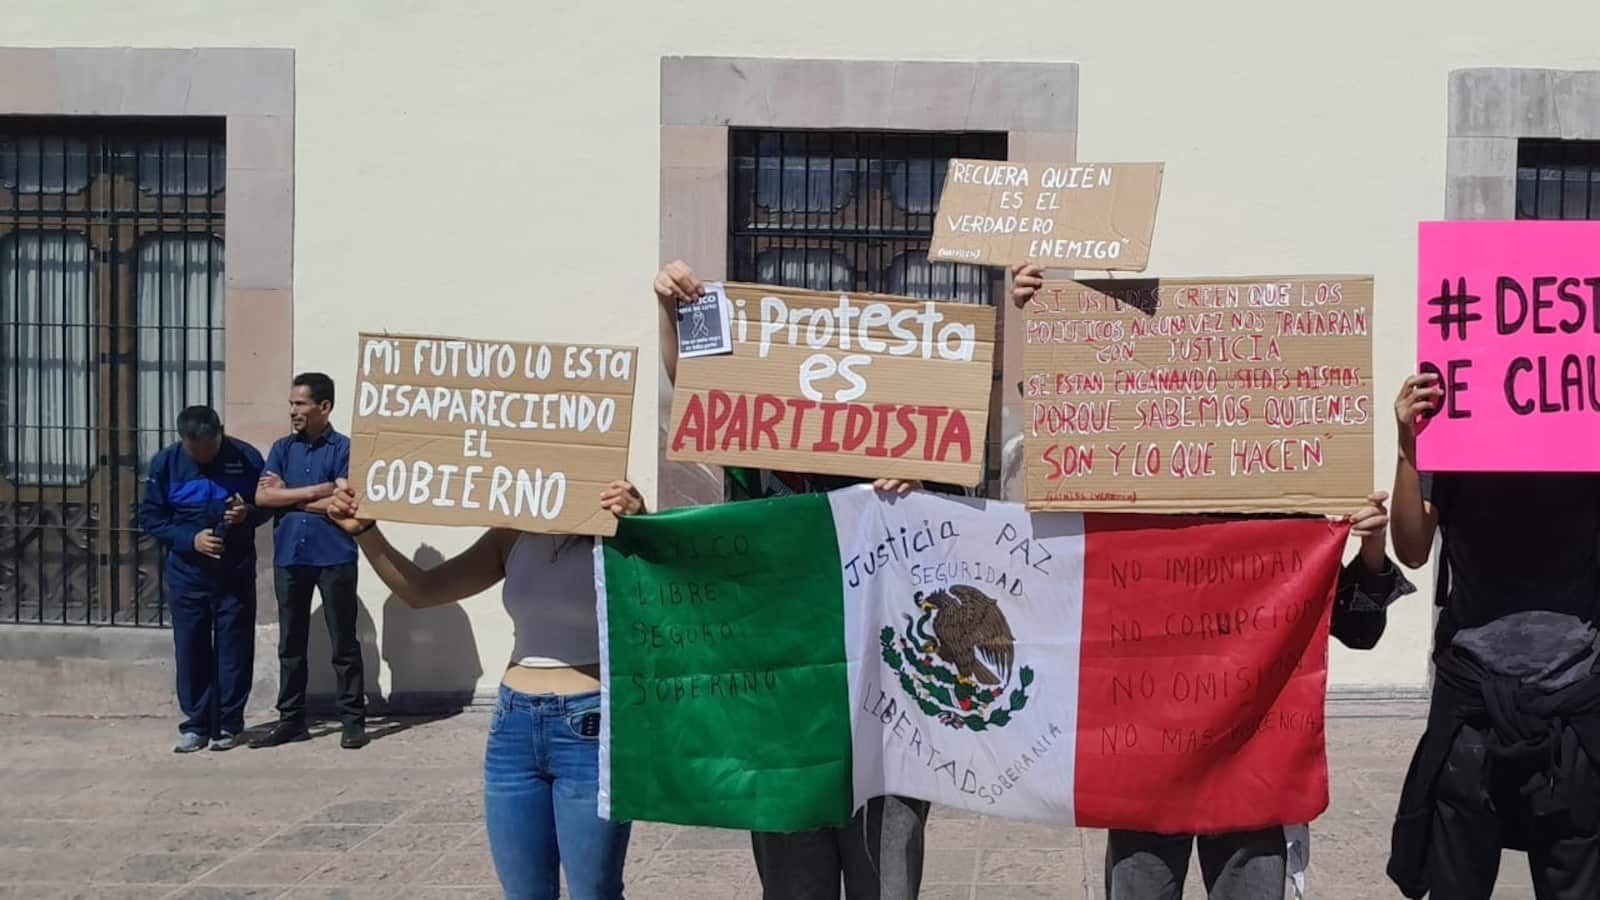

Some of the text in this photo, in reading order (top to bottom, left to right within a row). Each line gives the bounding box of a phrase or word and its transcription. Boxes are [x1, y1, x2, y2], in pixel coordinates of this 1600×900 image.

[1041, 164, 1112, 189] QUIÉN
[1000, 191, 1061, 211] ES EL
[947, 215, 1054, 235] VERDADERO
[1031, 288, 1066, 314] SI
[1174, 286, 1238, 309] CREEN
[1249, 283, 1291, 308] QUE
[1301, 283, 1342, 305] LOS
[729, 295, 976, 361] i Protesta
[1026, 318, 1124, 343] POLITICOS
[1231, 311, 1266, 331] NOS
[363, 340, 400, 376] Mi
[525, 345, 551, 380] LO
[1096, 335, 1281, 362] CON JUSTICIA
[800, 353, 872, 402] es
[1028, 372, 1050, 395] SE
[1055, 371, 1105, 394] ESTAN
[1226, 367, 1290, 390] USTEDES
[1419, 360, 1472, 419] DE
[359, 381, 616, 433] DESAPARECIENDO
[1033, 395, 1370, 436] PORQUE SABEMOS QUIENES
[463, 429, 493, 458] EL
[671, 389, 972, 463] APARTIDISTA
[1041, 443, 1096, 480] SON
[1107, 443, 1128, 476] Y
[1132, 442, 1161, 477] LO
[1170, 439, 1216, 479] QUE
[366, 459, 567, 520] GOBIERNO
[995, 522, 1052, 576] PAZ
[910, 561, 1024, 597] SEGURIDAD
[1111, 559, 1143, 589] NO
[636, 580, 718, 607] LIBRE
[1110, 622, 1142, 647] NO
[632, 666, 777, 705] SOBERANO
[1112, 671, 1155, 705] NO
[863, 680, 977, 795] LIBERTAD
[1101, 723, 1137, 756] NO
[1161, 728, 1215, 753] MAS
[978, 722, 1063, 805] SOBERANIA
